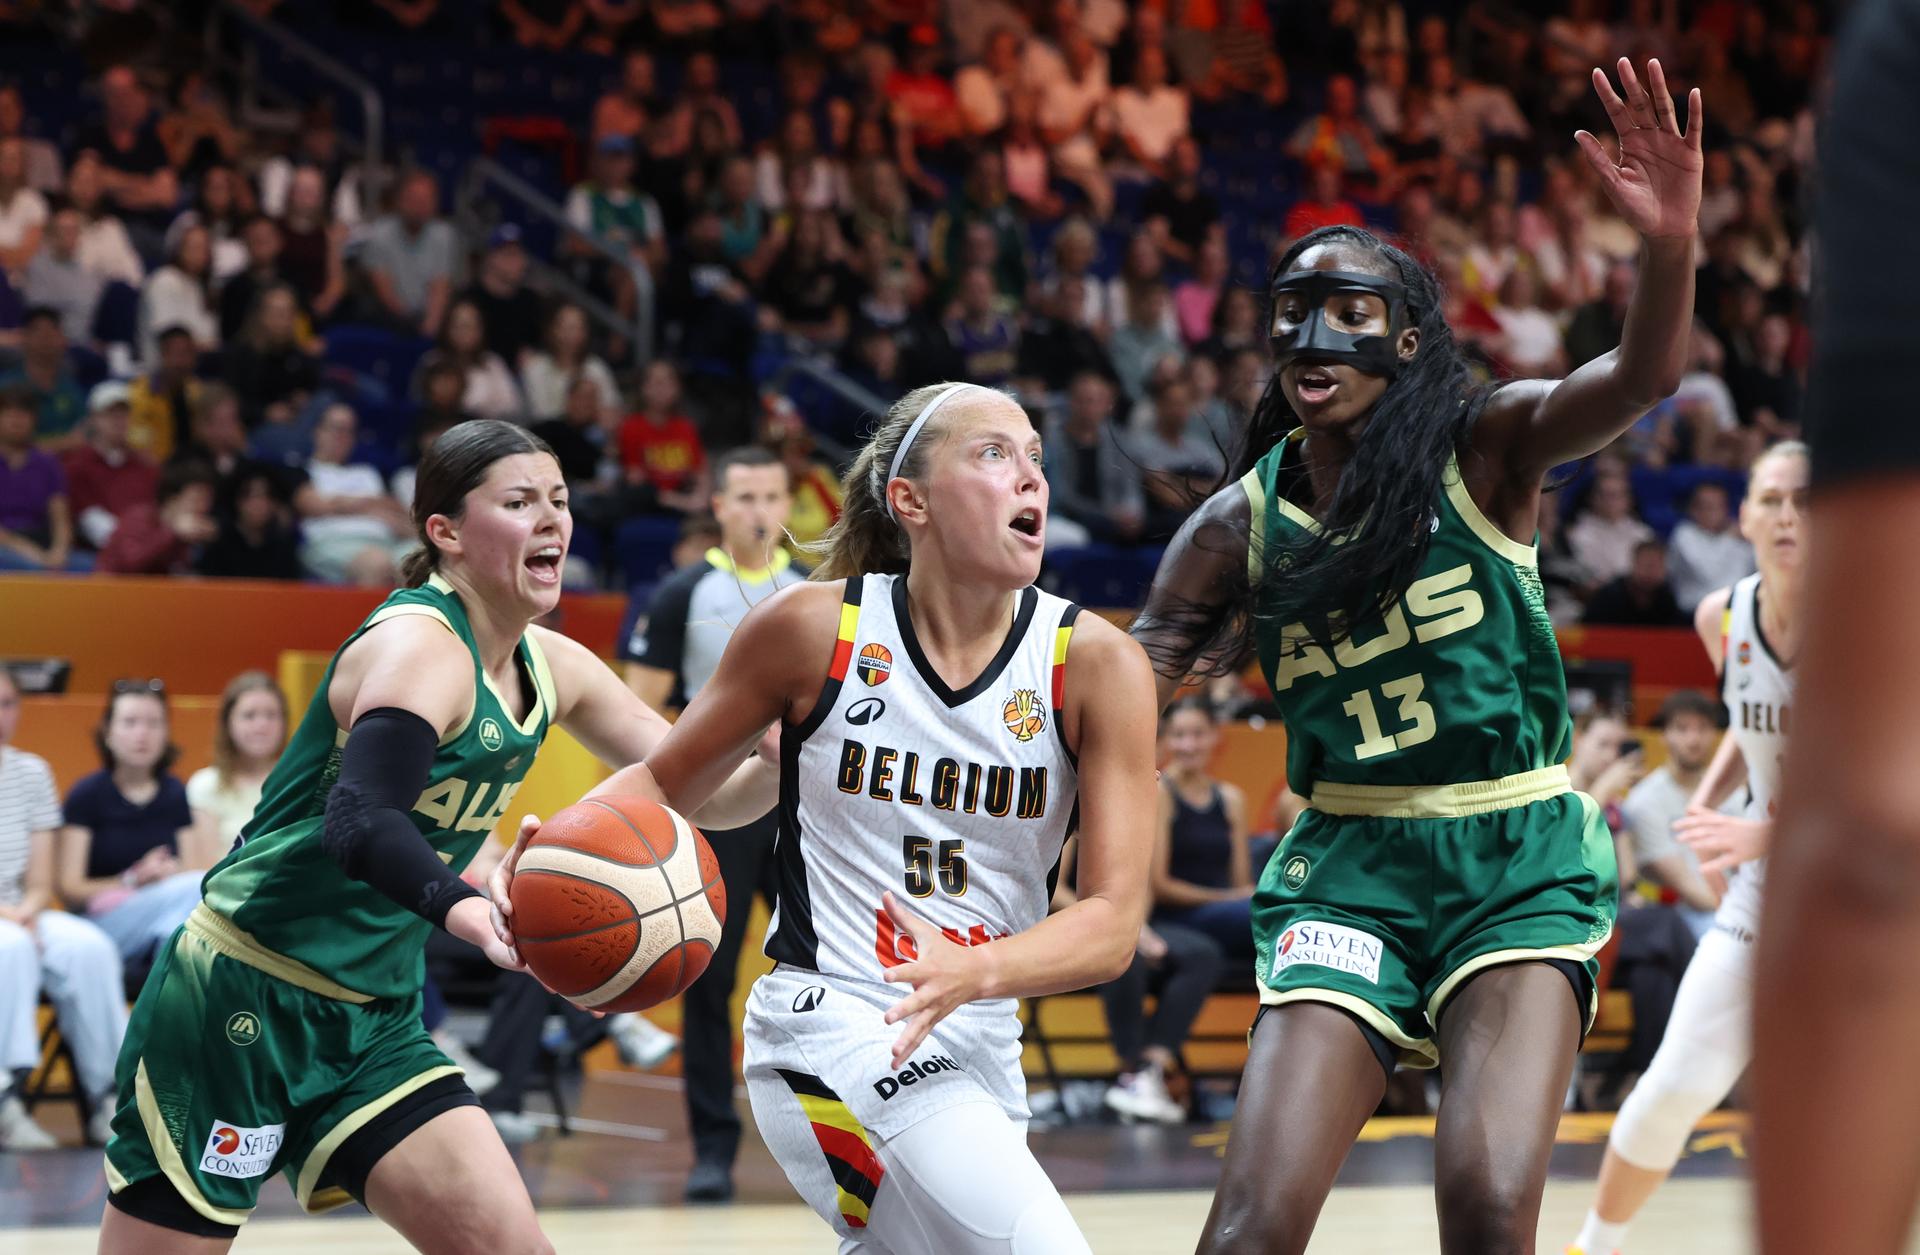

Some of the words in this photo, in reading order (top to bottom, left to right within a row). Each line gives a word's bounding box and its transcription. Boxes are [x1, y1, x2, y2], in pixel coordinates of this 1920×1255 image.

[1275, 563, 1485, 692] AUS
[1342, 672, 1437, 761] 13
[837, 738, 1048, 819] BELGIUM
[902, 835, 968, 899] 55
[1296, 925, 1379, 963] SEVEN
